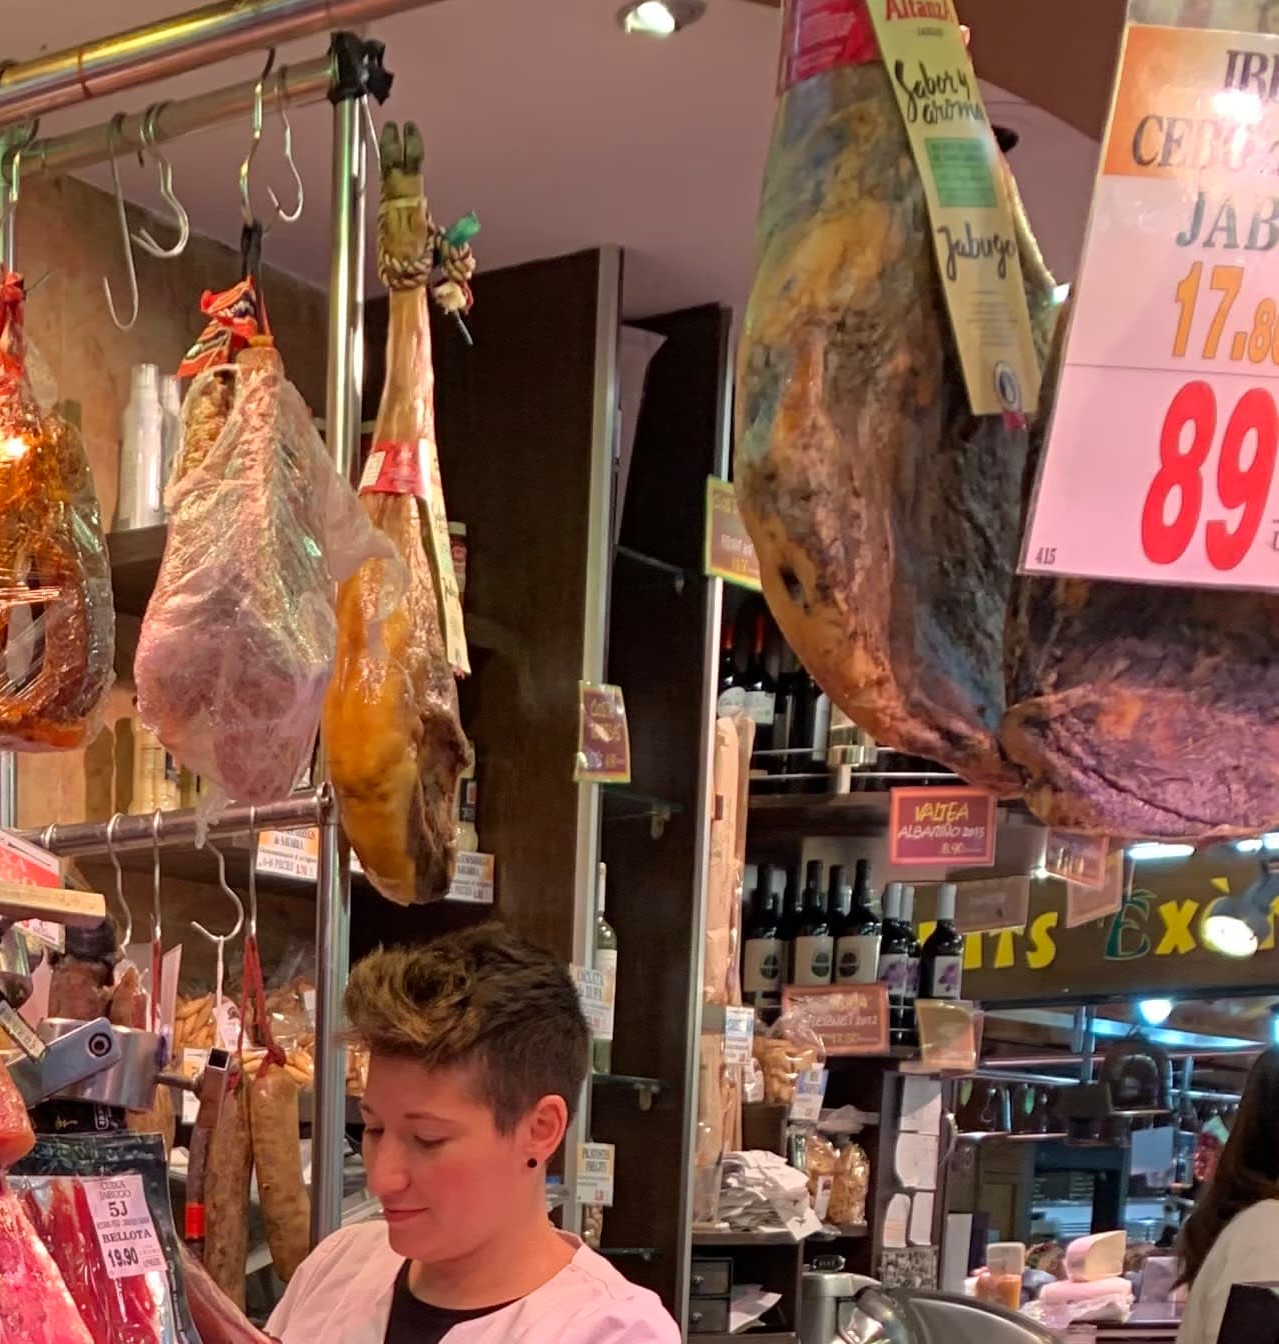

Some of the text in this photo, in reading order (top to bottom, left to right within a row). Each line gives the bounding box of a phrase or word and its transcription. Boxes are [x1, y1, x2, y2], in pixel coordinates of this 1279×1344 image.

[937, 221, 1016, 280] Jabugo
[1141, 380, 1279, 571] 89
[918, 911, 1058, 969] ITS
[108, 1201, 128, 1217] 5J
[102, 1229, 151, 1243] BELLOTA
[108, 1247, 139, 1267] 19.90
